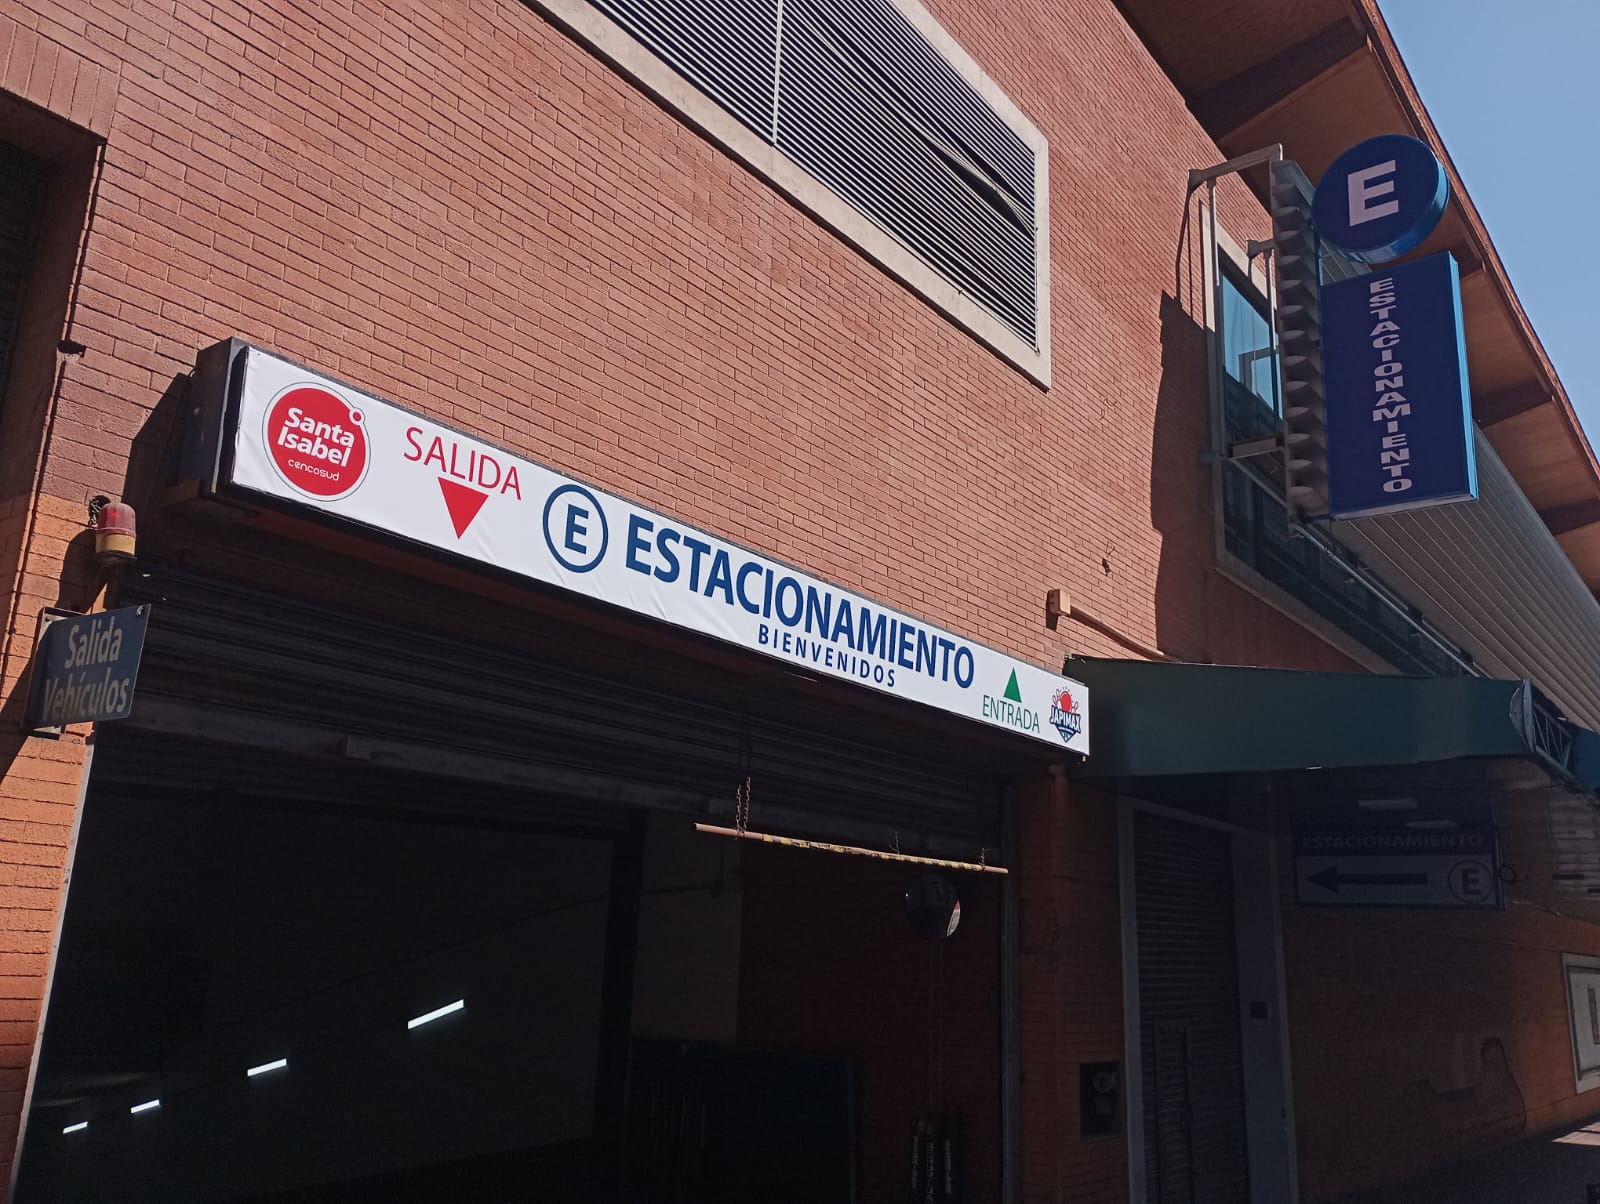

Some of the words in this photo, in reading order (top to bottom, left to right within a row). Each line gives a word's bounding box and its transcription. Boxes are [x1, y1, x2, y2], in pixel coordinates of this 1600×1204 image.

[1347, 159, 1399, 227] E
[1369, 277, 1412, 493] ESTACIONAMIENTO
[277, 426, 352, 468] Isabel
[284, 407, 355, 448] Santa
[288, 458, 340, 481] cencosud
[403, 426, 522, 501] SALIDA
[564, 503, 589, 555] E
[625, 513, 975, 689] ESTACIONAMIENTO
[64, 615, 123, 669] Salida
[758, 623, 896, 688] BIENVENIDOS
[42, 667, 130, 721] Vehículos
[982, 694, 1040, 733] ENTRADA
[1049, 705, 1081, 733] JAPIMAX
[1302, 832, 1483, 850] ESTACIONAMIENTO
[1461, 868, 1482, 896] E
